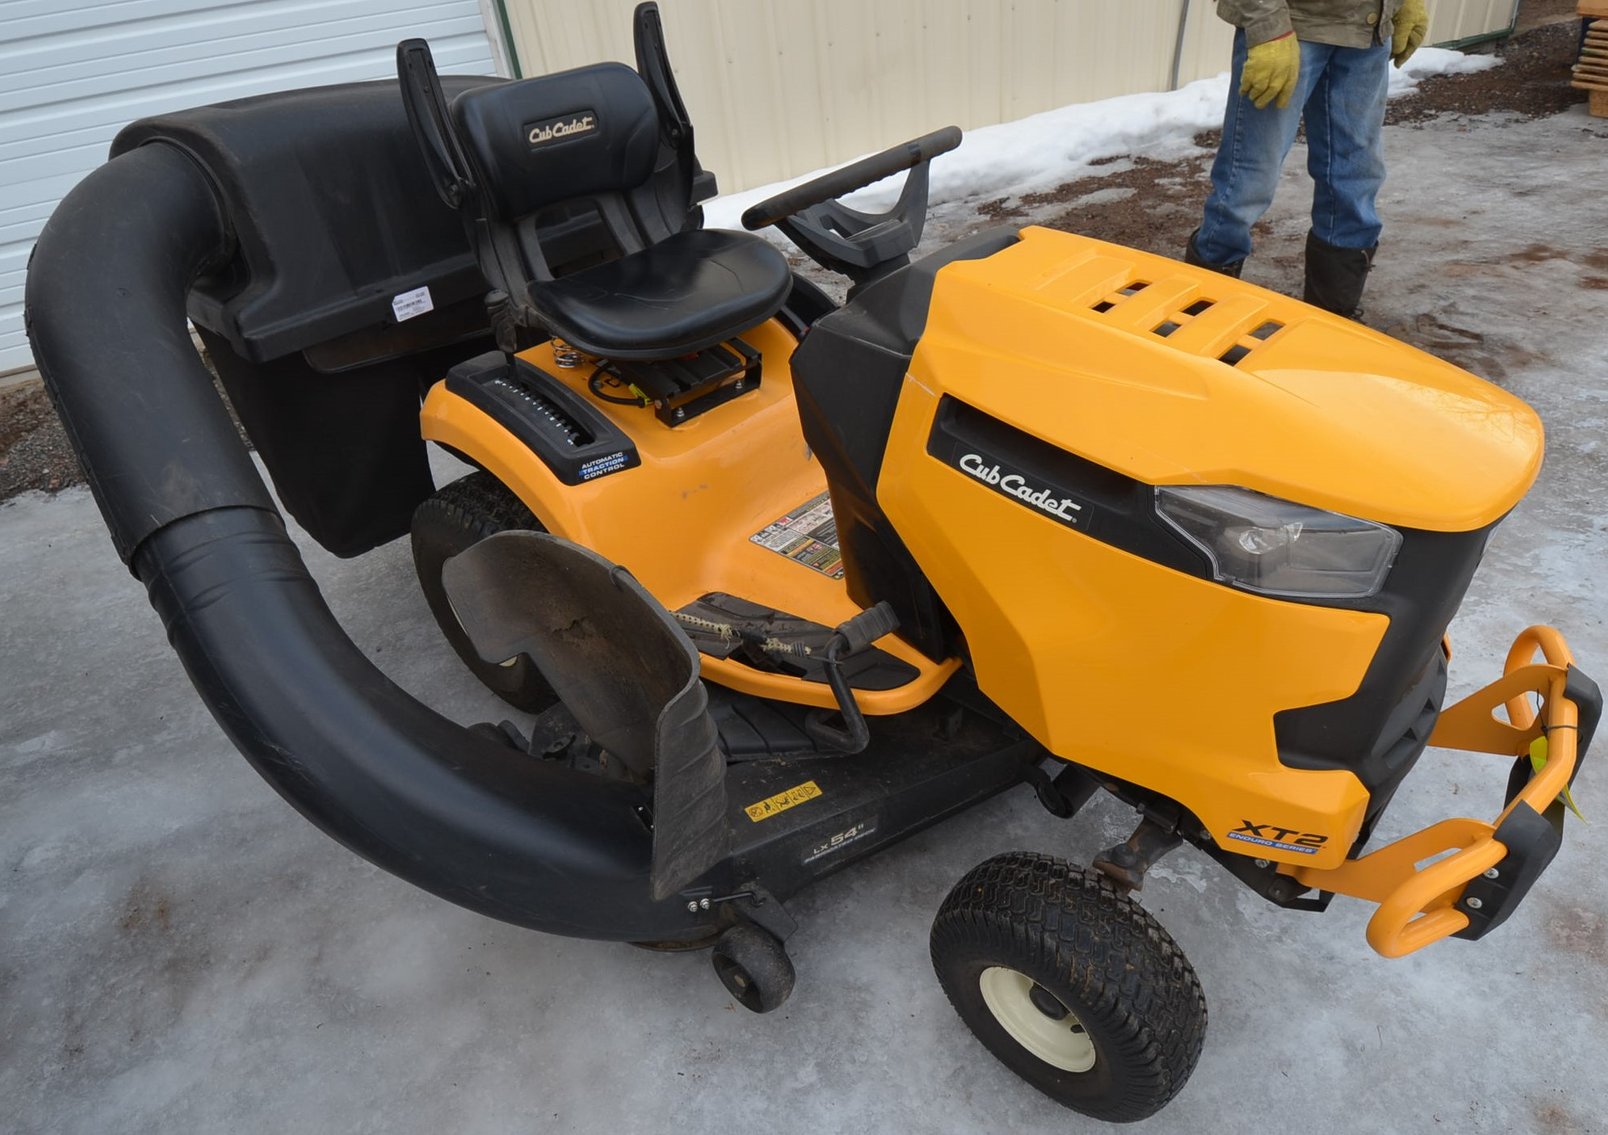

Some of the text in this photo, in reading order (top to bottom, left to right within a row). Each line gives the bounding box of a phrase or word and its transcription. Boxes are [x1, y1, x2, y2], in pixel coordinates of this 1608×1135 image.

[529, 117, 593, 143] Cub Cadet
[582, 452, 623, 469] AUTOMATIC
[583, 457, 625, 474] TRACTION
[584, 464, 625, 480] CONTROL
[959, 454, 1082, 521] Cub Cadet
[1229, 833, 1313, 853] ENDURO SERIES
[1232, 819, 1328, 848] XT2
